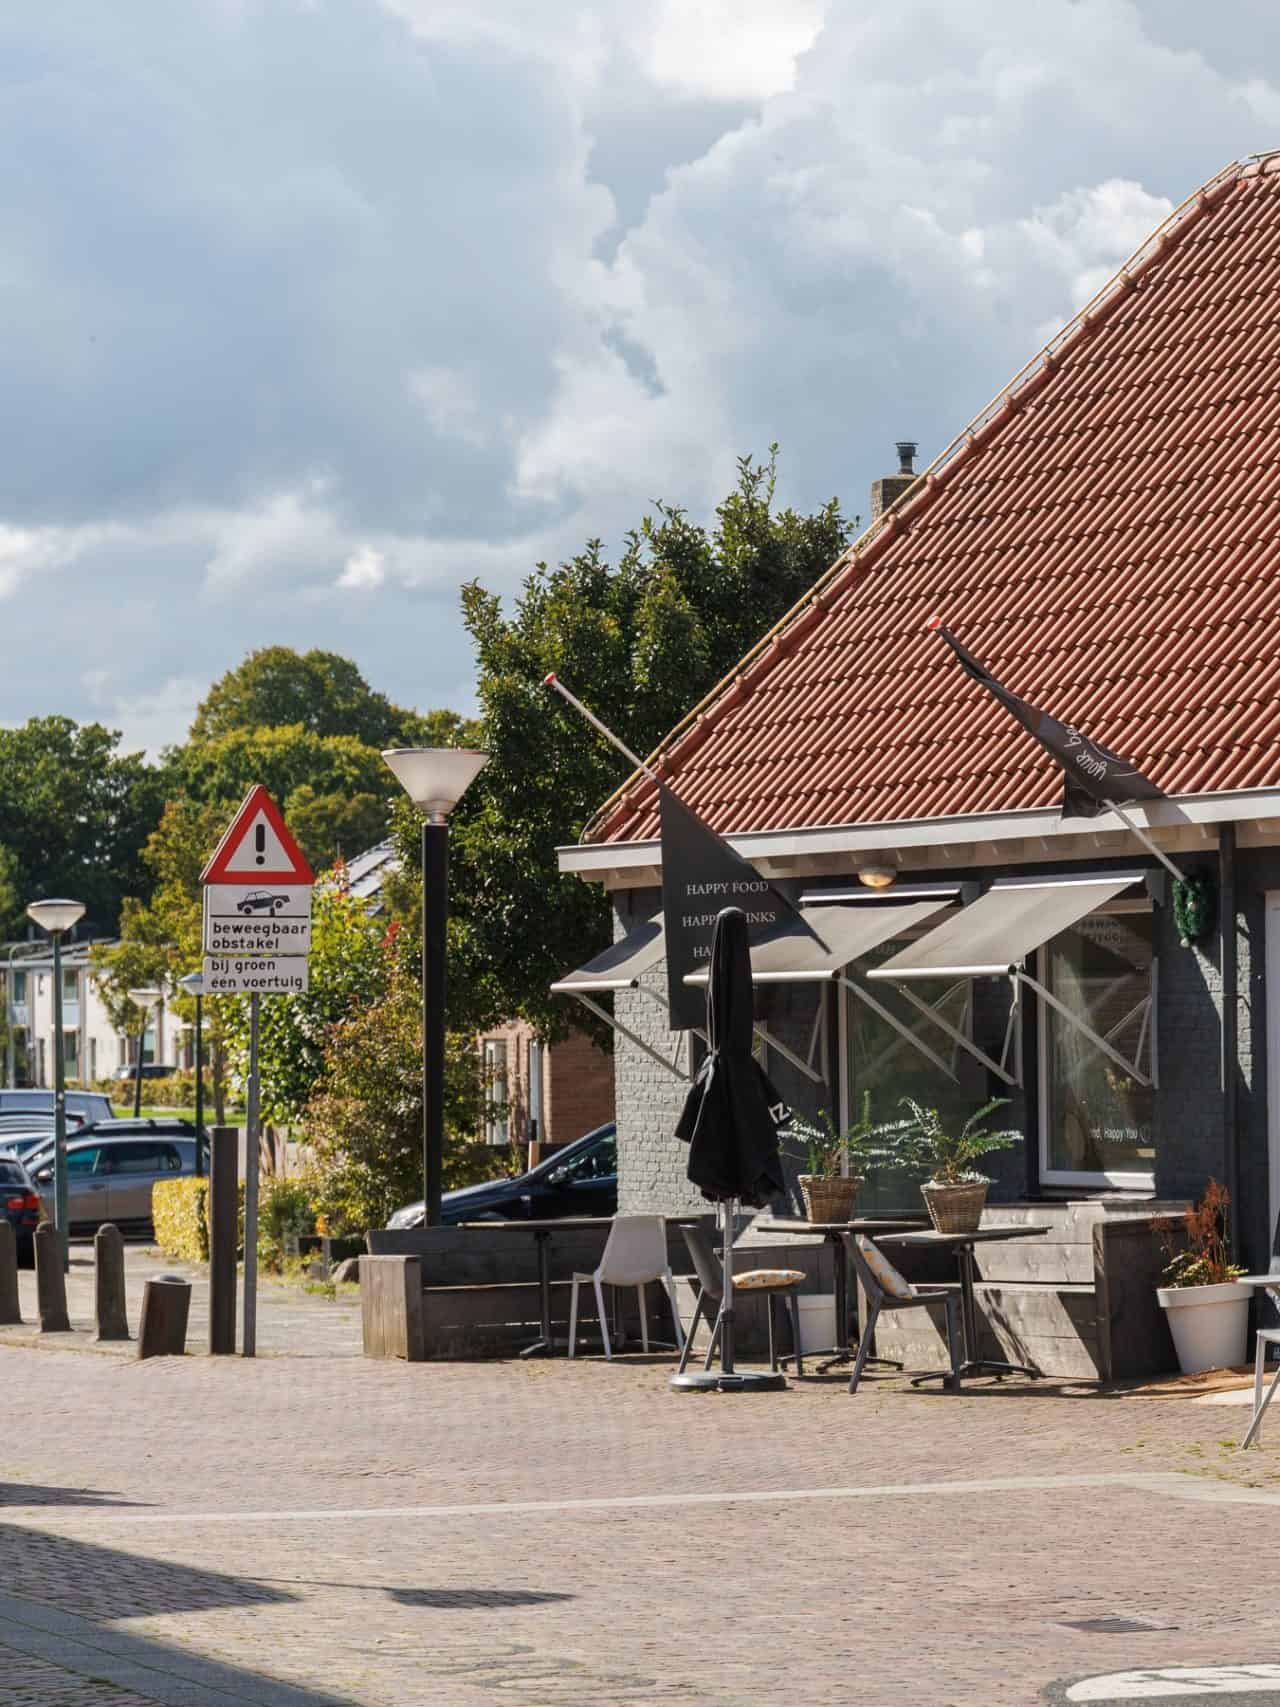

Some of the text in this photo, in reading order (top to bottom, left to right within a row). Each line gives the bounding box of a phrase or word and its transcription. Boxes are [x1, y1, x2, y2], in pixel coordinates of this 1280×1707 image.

[686, 880, 769, 896] HAPPY FOOD
[682, 911, 776, 927] HAPP INKS
[213, 922, 307, 937] beweegbaar
[212, 938, 279, 949] obstakel
[211, 959, 276, 974] bij groen
[242, 976, 303, 990] voertuig
